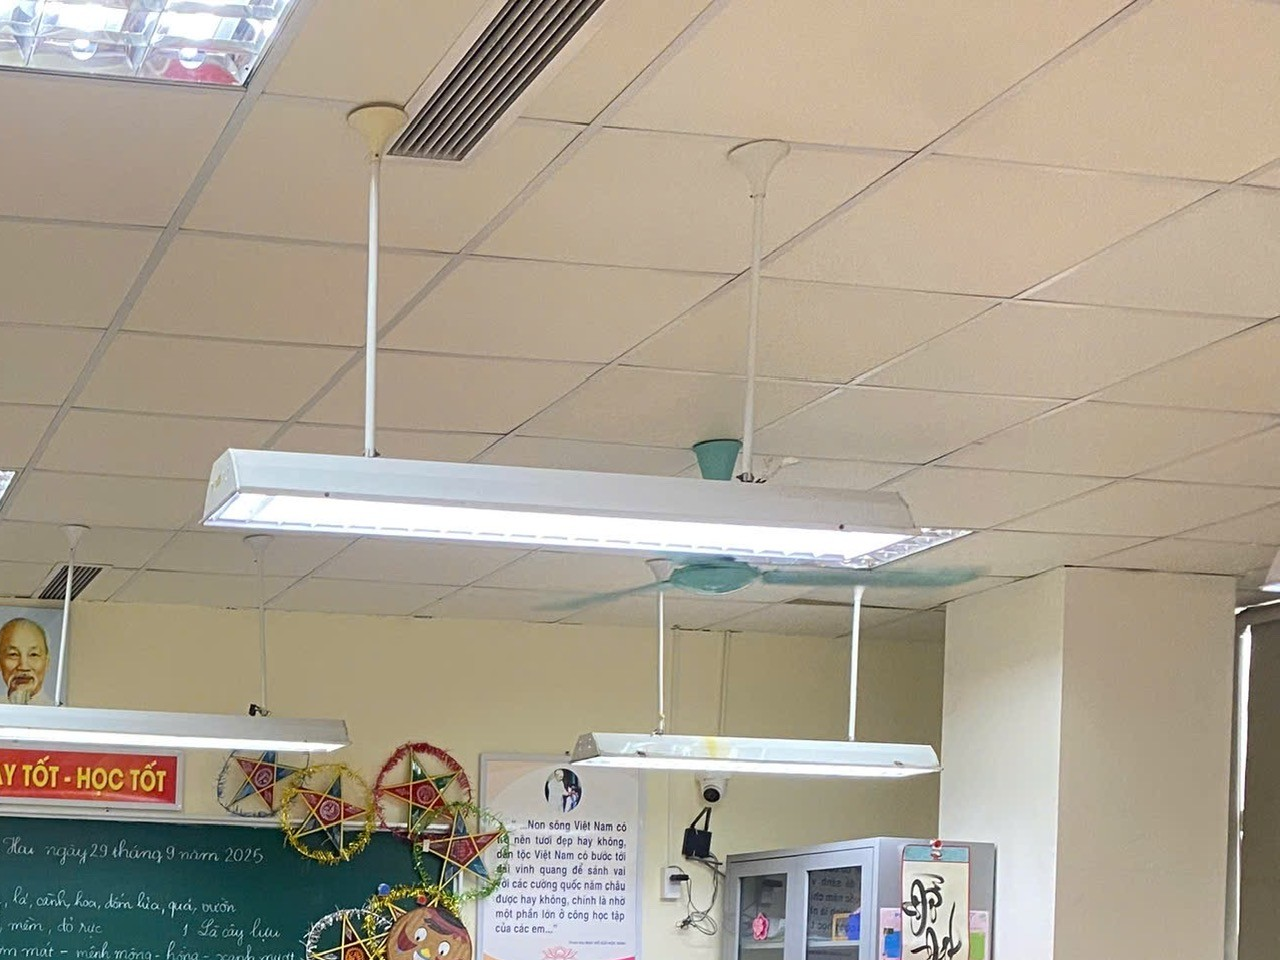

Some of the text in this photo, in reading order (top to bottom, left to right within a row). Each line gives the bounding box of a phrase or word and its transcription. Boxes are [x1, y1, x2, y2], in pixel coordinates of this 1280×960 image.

[22, 755, 60, 788] TỐT
[76, 766, 124, 796] HỌC
[129, 759, 167, 793] TỐT
[549, 821, 571, 832] sông
[574, 820, 590, 831] Việt
[594, 821, 613, 832] Nam
[616, 821, 627, 832] có
[514, 834, 531, 844] nên
[535, 836, 552, 845] tươi
[556, 836, 573, 847] đẹp
[577, 836, 592, 848] hay
[45, 844, 88, 865] ngày
[89, 843, 108, 858] 29
[113, 839, 163, 864] tháng
[166, 846, 175, 861] 9
[517, 850, 531, 860] tộc
[534, 850, 551, 860] Việt
[554, 851, 574, 860] Nam
[577, 851, 588, 860] có
[591, 851, 612, 861] bước
[615, 851, 626, 861] tới
[515, 862, 626, 877] vinh quang để sánh vai
[512, 880, 528, 888] các
[560, 878, 582, 891] quốc
[584, 881, 603, 890] năm
[605, 881, 626, 891] châu
[495, 894, 518, 906] được
[521, 895, 537, 906] hay
[571, 895, 597, 905] chính
[599, 896, 607, 905] là
[609, 896, 626, 906] nhờ
[495, 909, 513, 920] một
[516, 908, 539, 920] phần
[542, 910, 556, 919] lớn
[567, 910, 589, 922] công
[592, 910, 609, 921] học
[611, 911, 625, 923] tập
[495, 922, 529, 933] của các
[222, 924, 244, 946] cây
